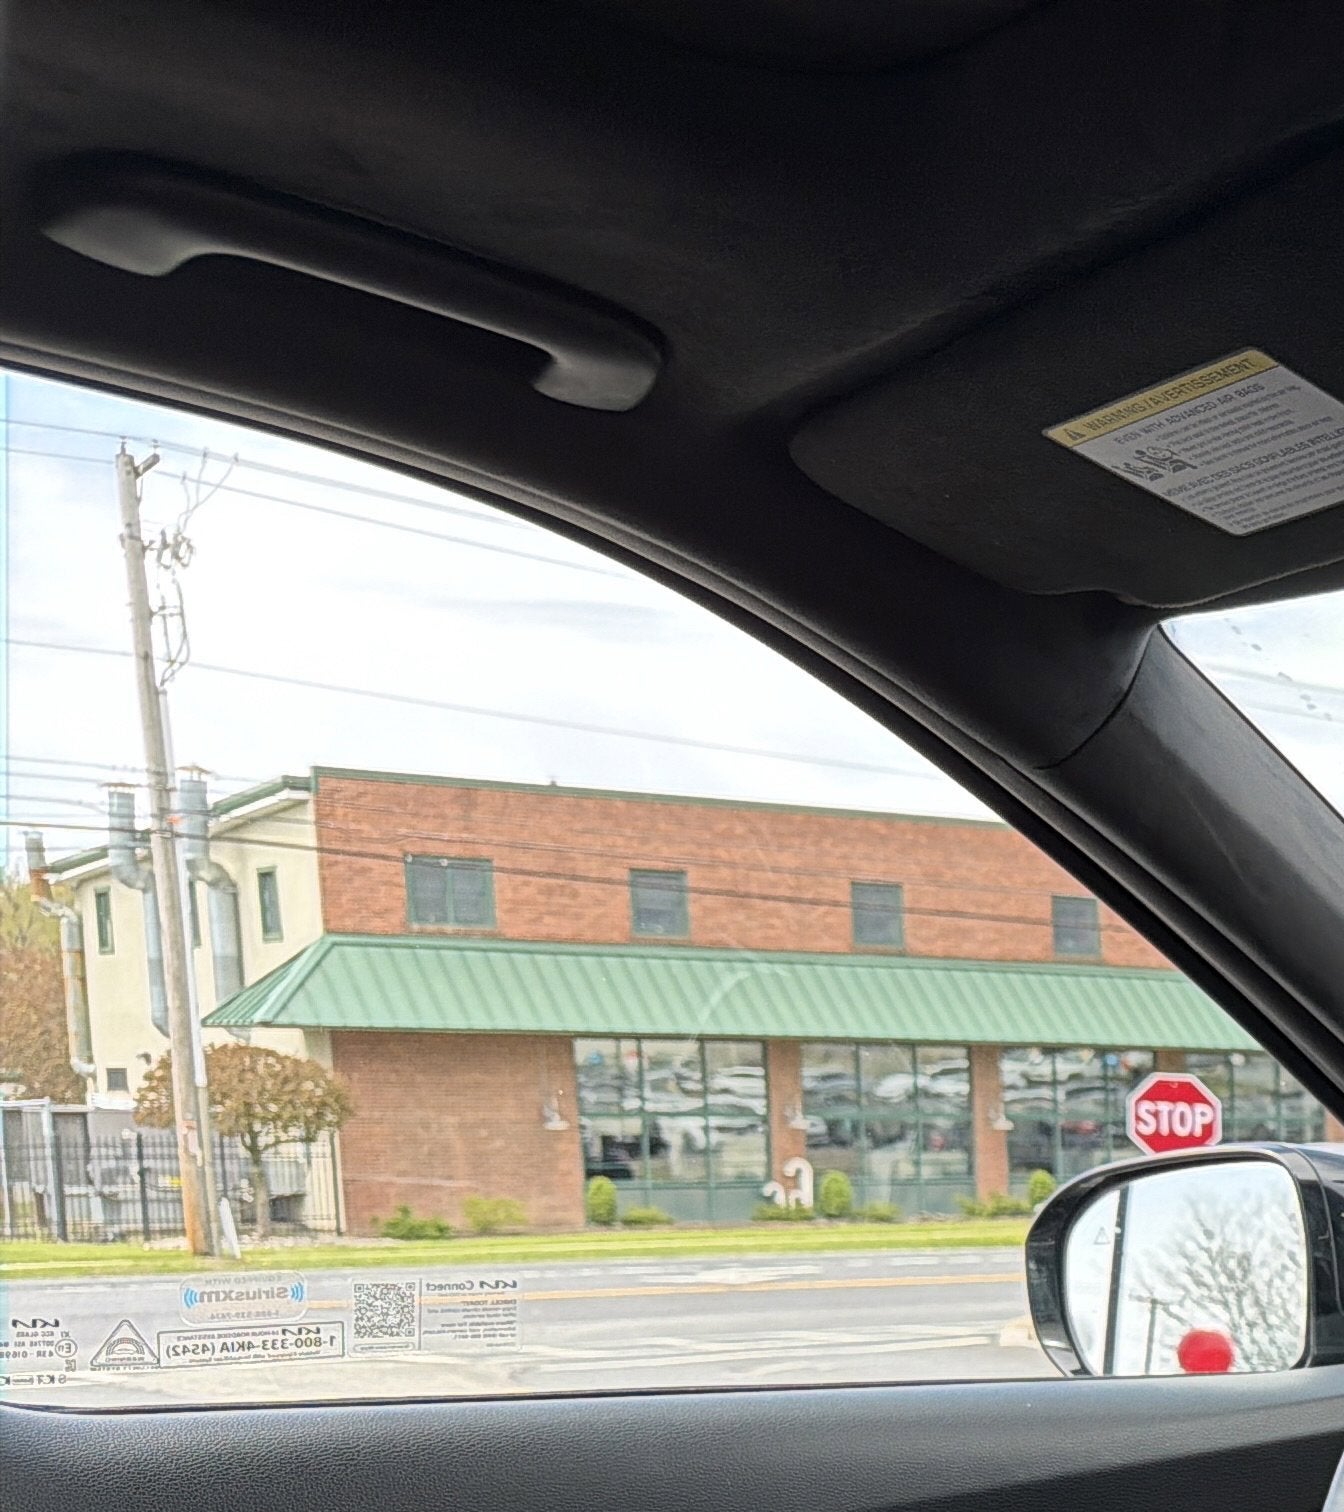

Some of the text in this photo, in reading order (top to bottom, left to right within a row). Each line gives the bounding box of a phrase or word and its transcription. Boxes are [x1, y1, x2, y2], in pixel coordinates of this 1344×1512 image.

[1142, 421, 1165, 435] WITH
[1165, 401, 1218, 426] ADVANCED
[1218, 393, 1235, 406] AIR
[1235, 382, 1266, 399] BAGS
[1136, 1100, 1214, 1137] STOP
